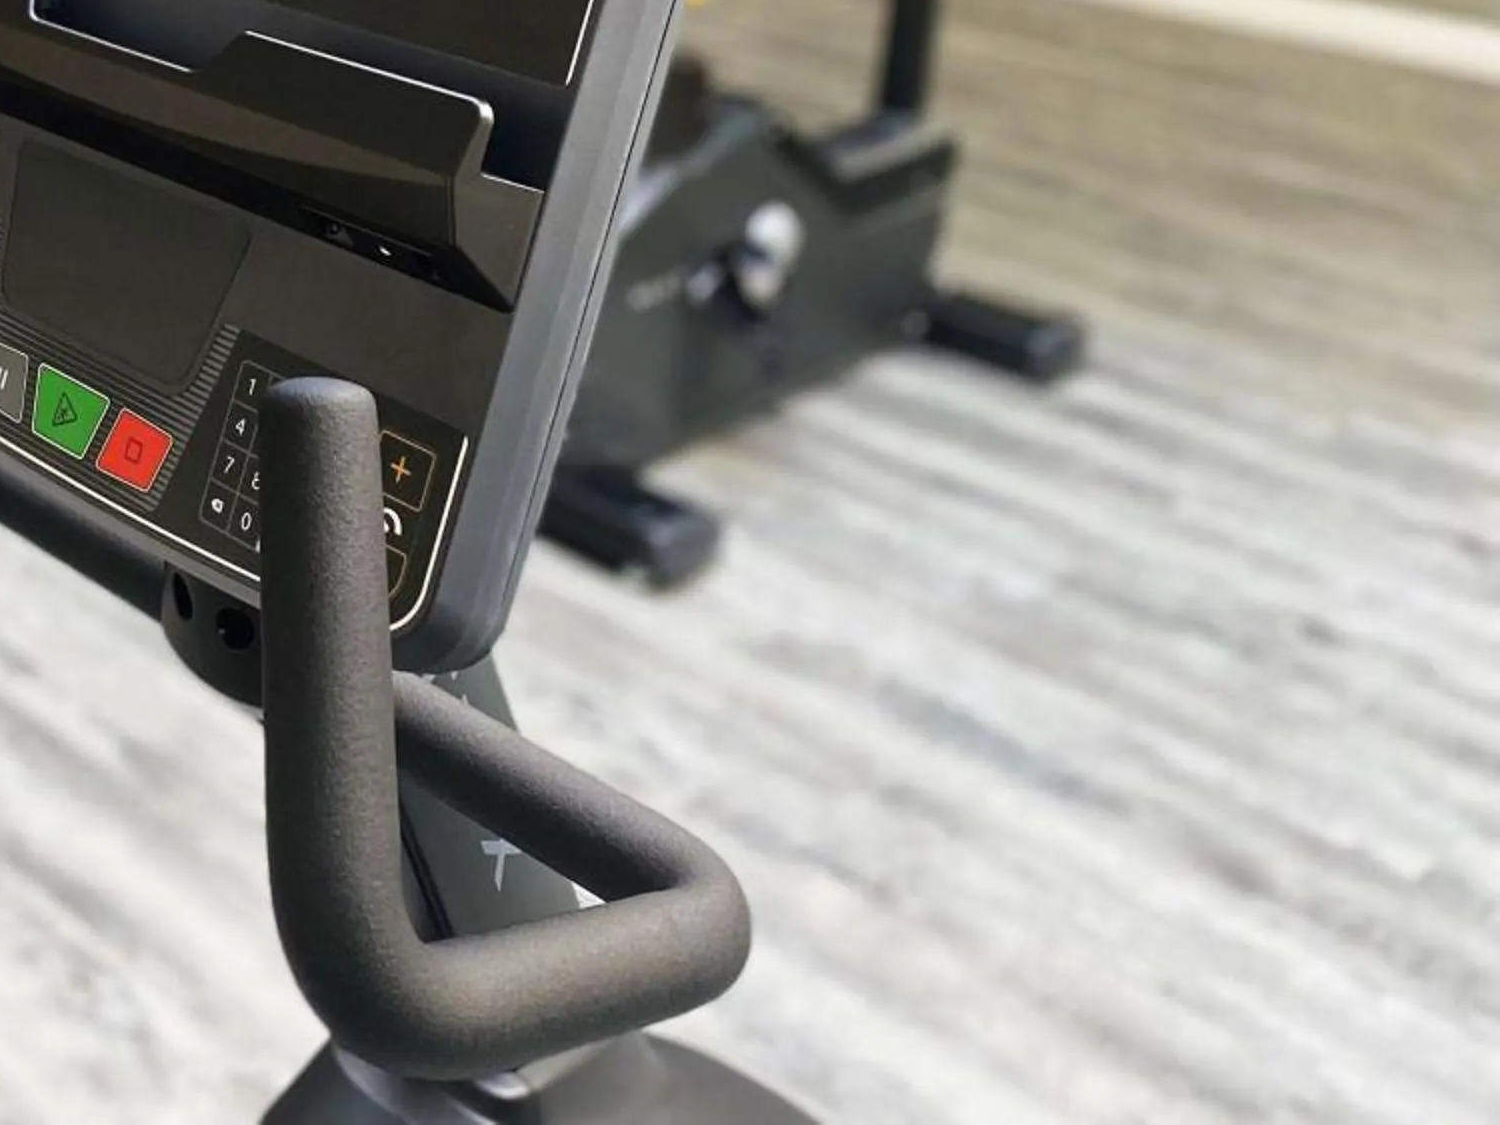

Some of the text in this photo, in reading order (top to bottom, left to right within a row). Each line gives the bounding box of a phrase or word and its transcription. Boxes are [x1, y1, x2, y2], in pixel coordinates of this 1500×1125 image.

[248, 378, 257, 396] 1
[235, 418, 246, 436] 4
[224, 456, 235, 474] 7
[240, 512, 252, 531] 0
